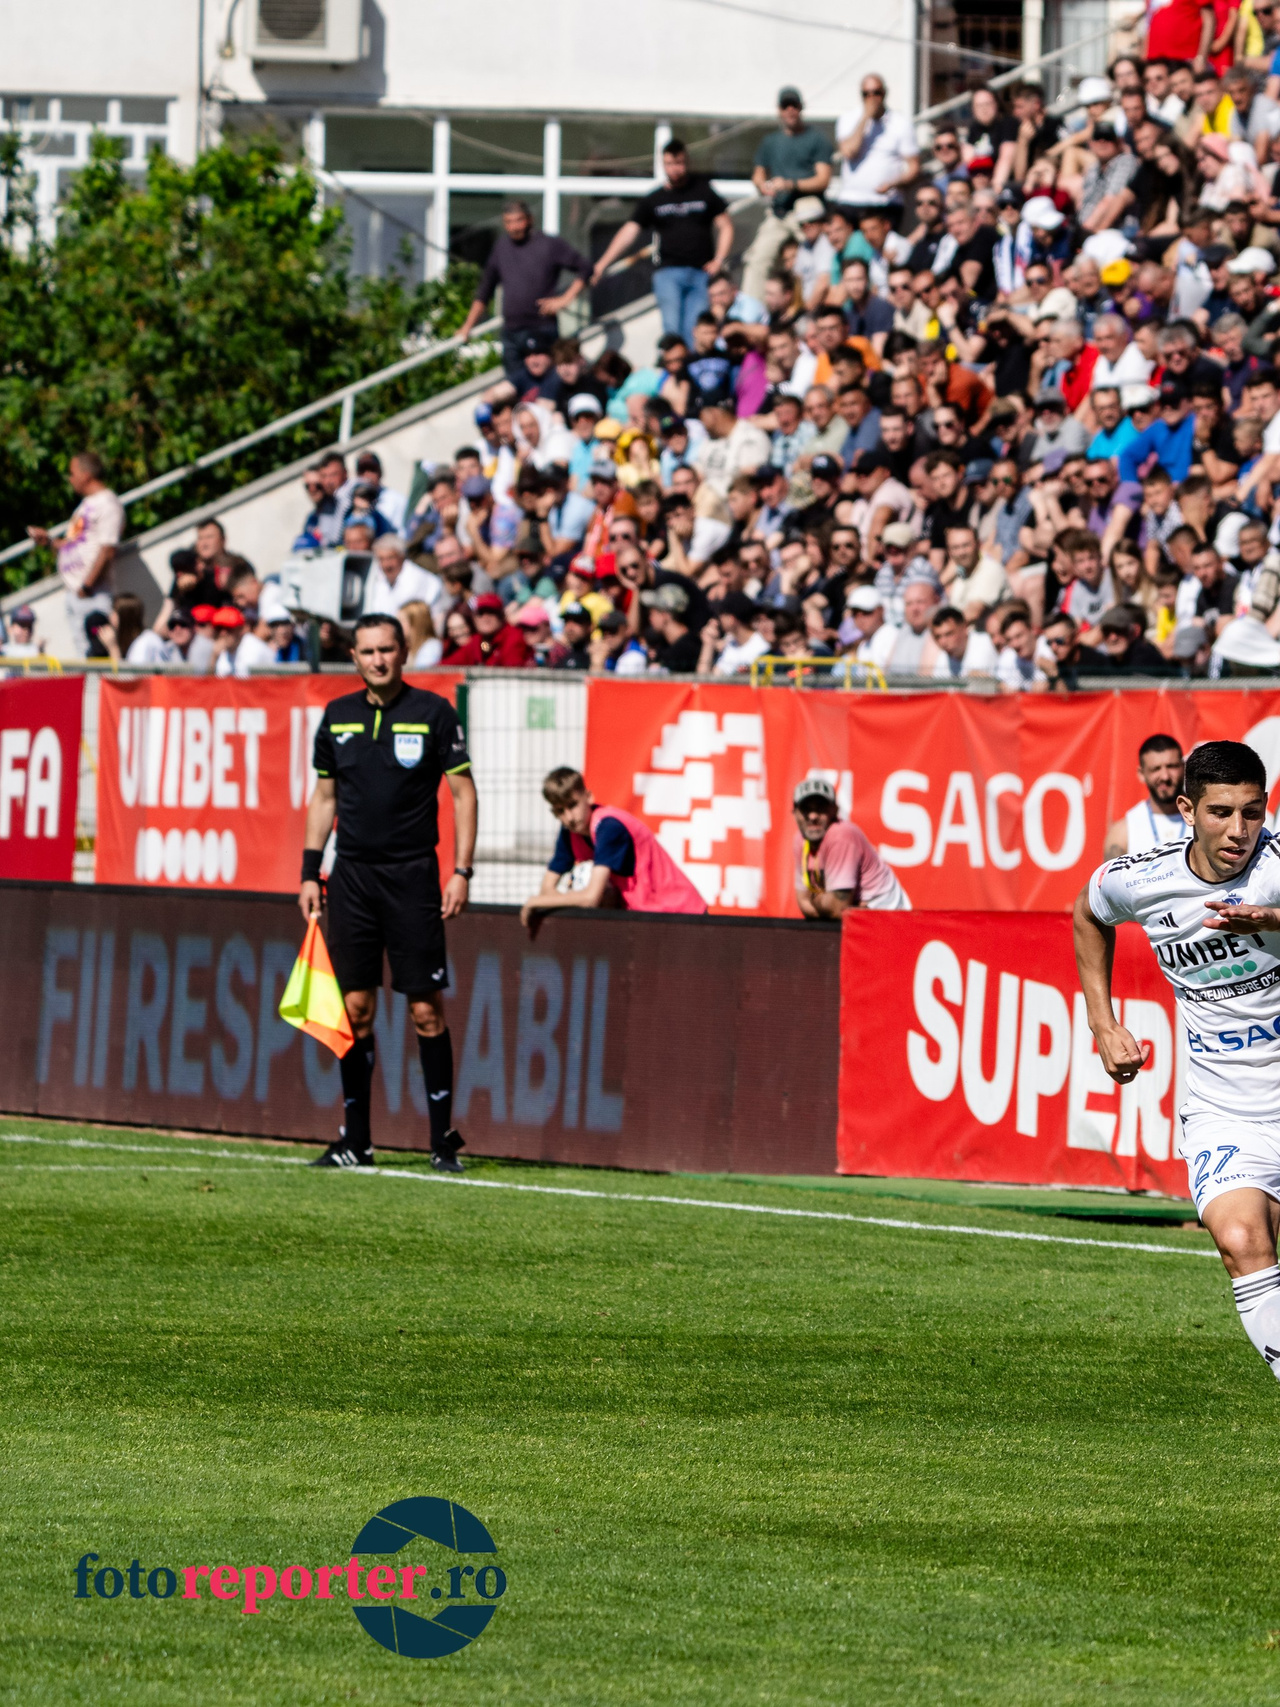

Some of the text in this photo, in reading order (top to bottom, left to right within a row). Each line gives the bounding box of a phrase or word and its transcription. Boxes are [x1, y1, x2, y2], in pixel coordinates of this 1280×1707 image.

[398, 736, 419, 745] FIFA
[1125, 871, 1174, 888] ELECTROALFA
[1234, 979, 1262, 995] SPRE
[1260, 971, 1280, 987] 0%
[36, 926, 116, 1088] FII
[907, 939, 1186, 1161] SUPER
[1194, 1144, 1241, 1190] 27
